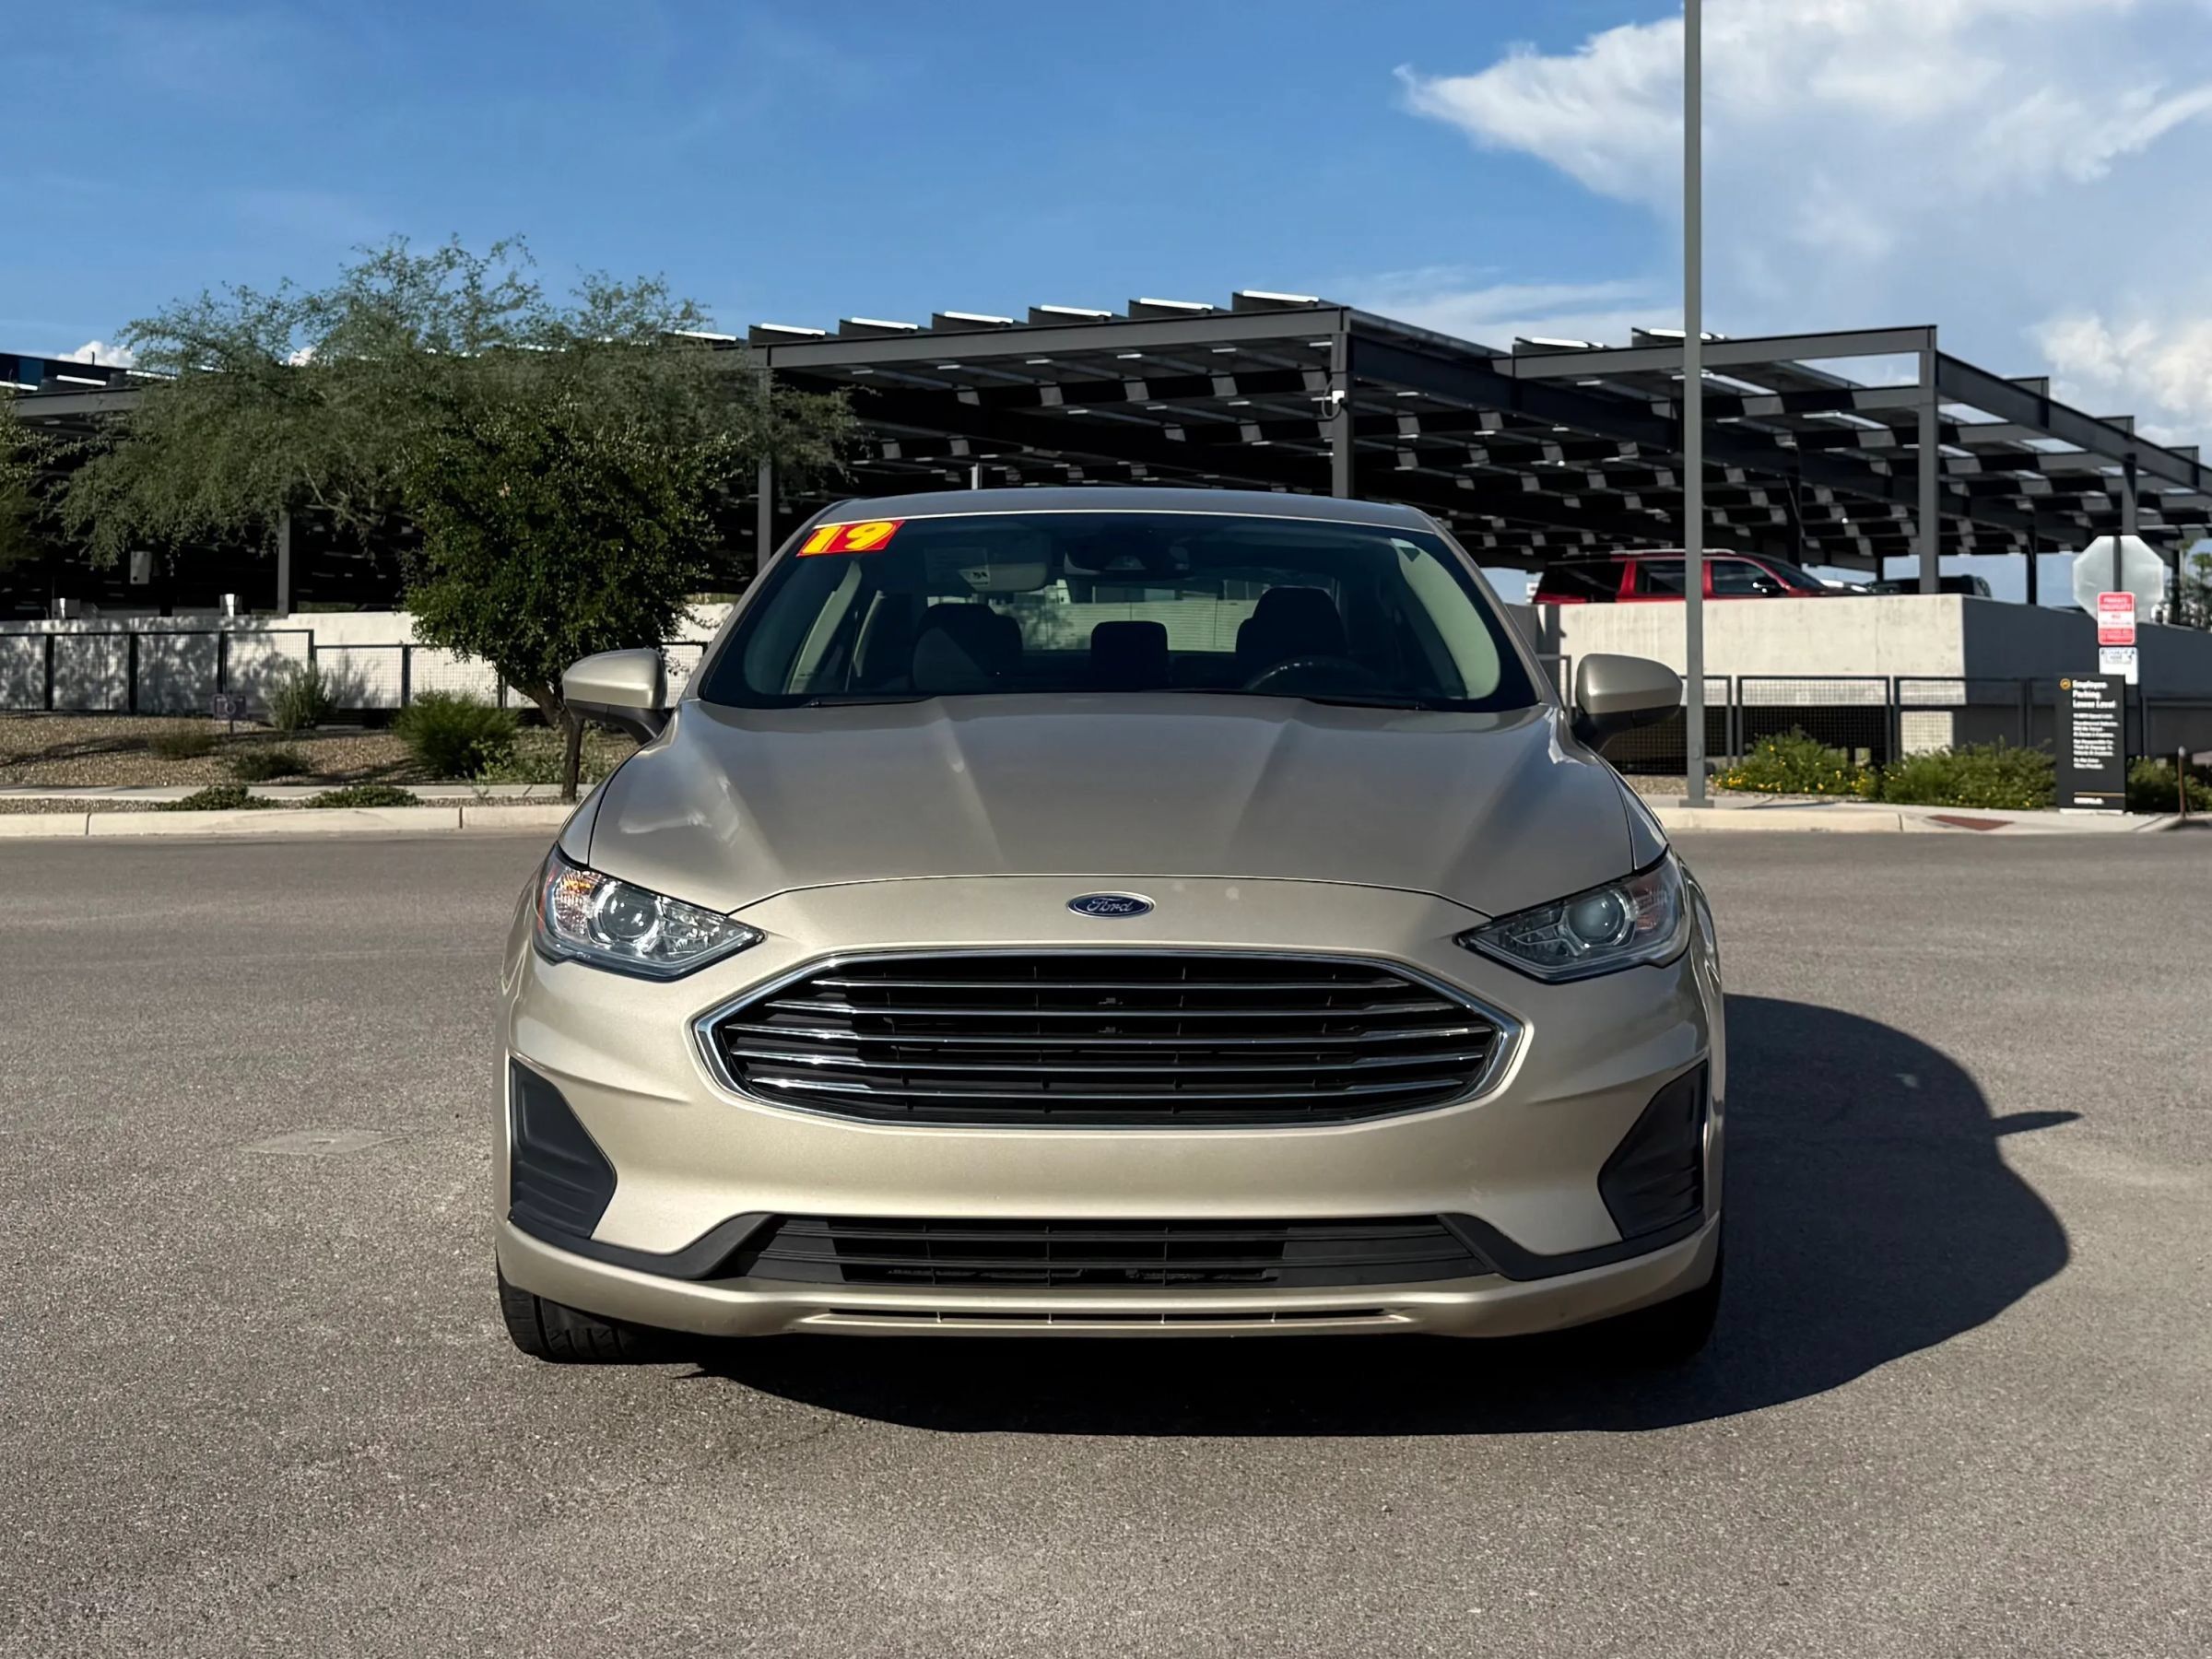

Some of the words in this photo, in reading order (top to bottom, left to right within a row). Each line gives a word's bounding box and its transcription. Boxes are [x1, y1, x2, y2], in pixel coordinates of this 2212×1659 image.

[801, 522, 897, 554] 19
[2072, 689, 2101, 700] Parking
[1087, 897, 1135, 912] Ford
